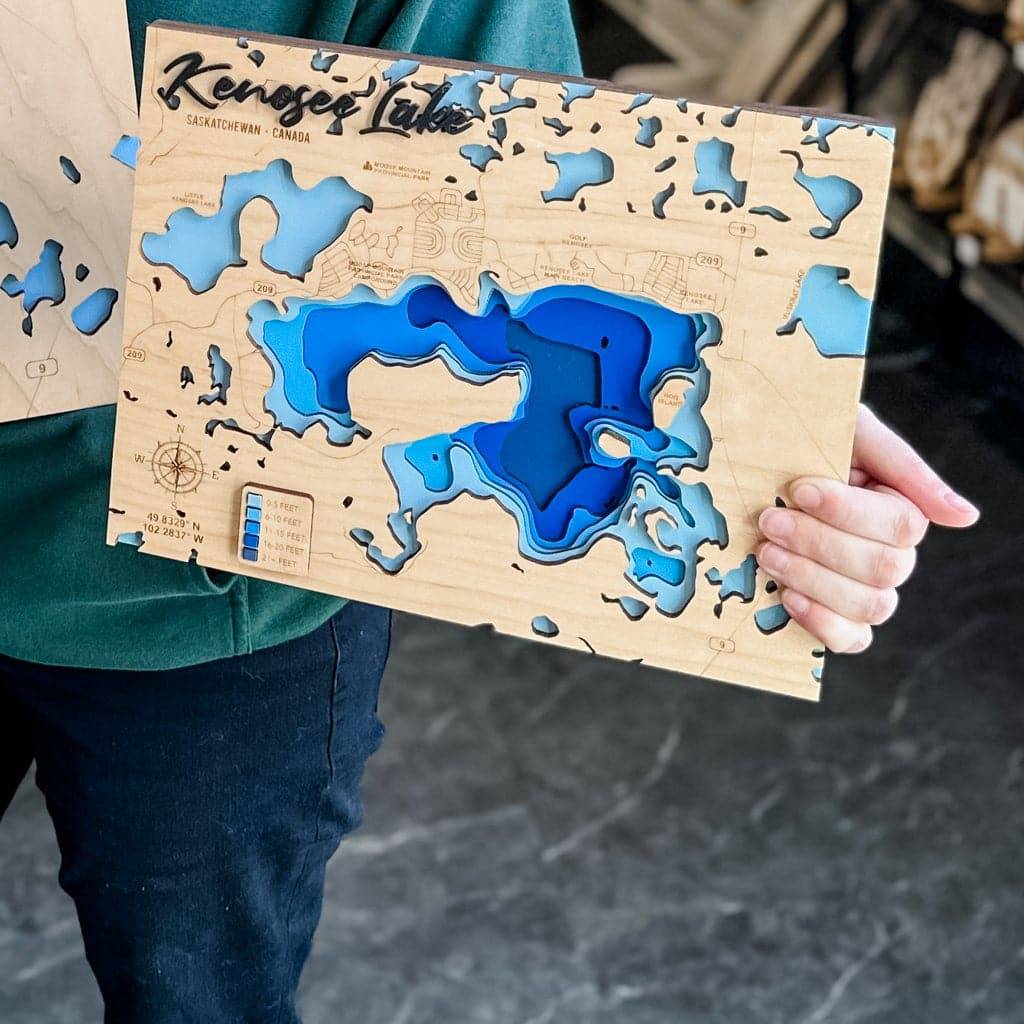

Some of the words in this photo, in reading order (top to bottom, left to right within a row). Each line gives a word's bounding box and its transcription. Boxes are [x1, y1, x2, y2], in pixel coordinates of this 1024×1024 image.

[163, 51, 362, 126] Kenosee
[359, 81, 474, 138] Lake
[186, 113, 262, 136] SASKATCHEWAN
[272, 127, 311, 144] CANADA
[700, 256, 719, 266] 209
[256, 283, 273, 294] 209
[127, 349, 143, 359] 209
[38, 363, 46, 373] 9
[176, 424, 185, 433] N
[134, 454, 145, 464] W
[211, 471, 219, 480] E
[171, 501, 178, 511] S
[192, 522, 201, 532] N
[193, 535, 204, 544] W
